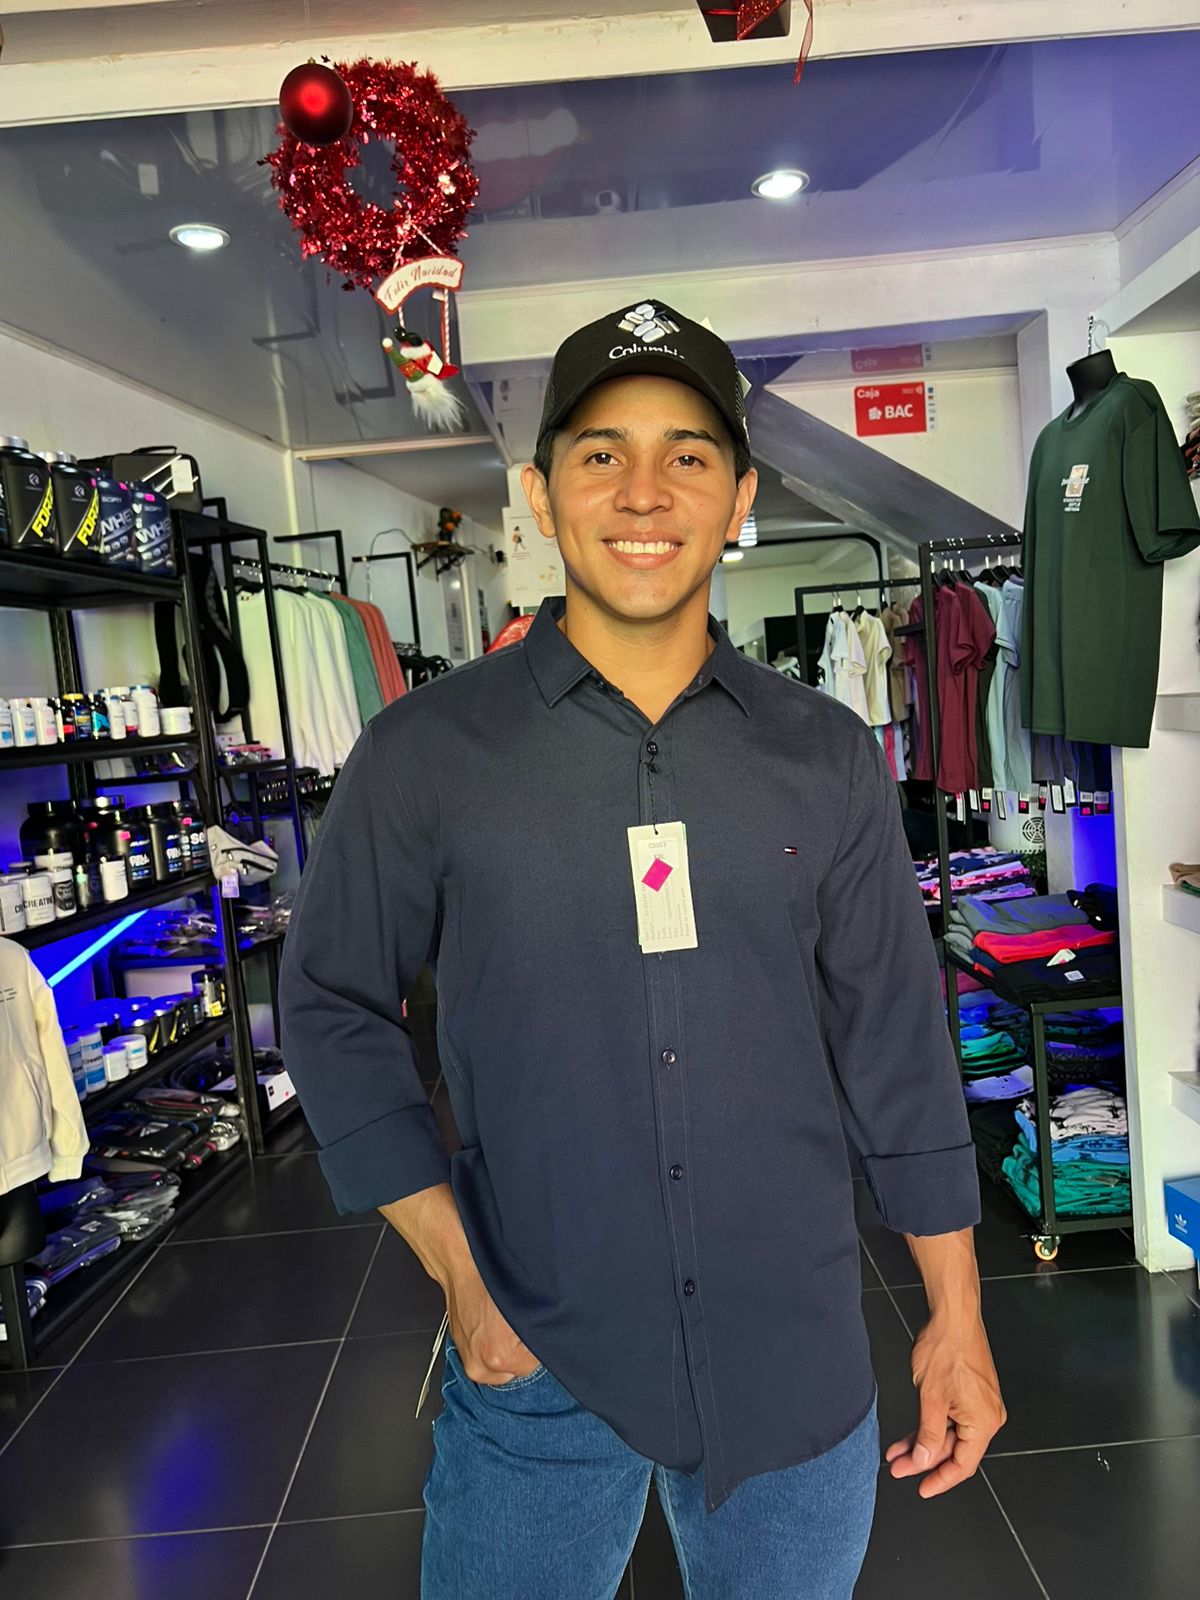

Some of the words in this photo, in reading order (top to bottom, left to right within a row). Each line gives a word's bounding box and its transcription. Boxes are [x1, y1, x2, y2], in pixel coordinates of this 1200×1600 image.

[411, 265, 458, 281] Navidad
[856, 388, 880, 399] Caja
[884, 403, 914, 419] BAC
